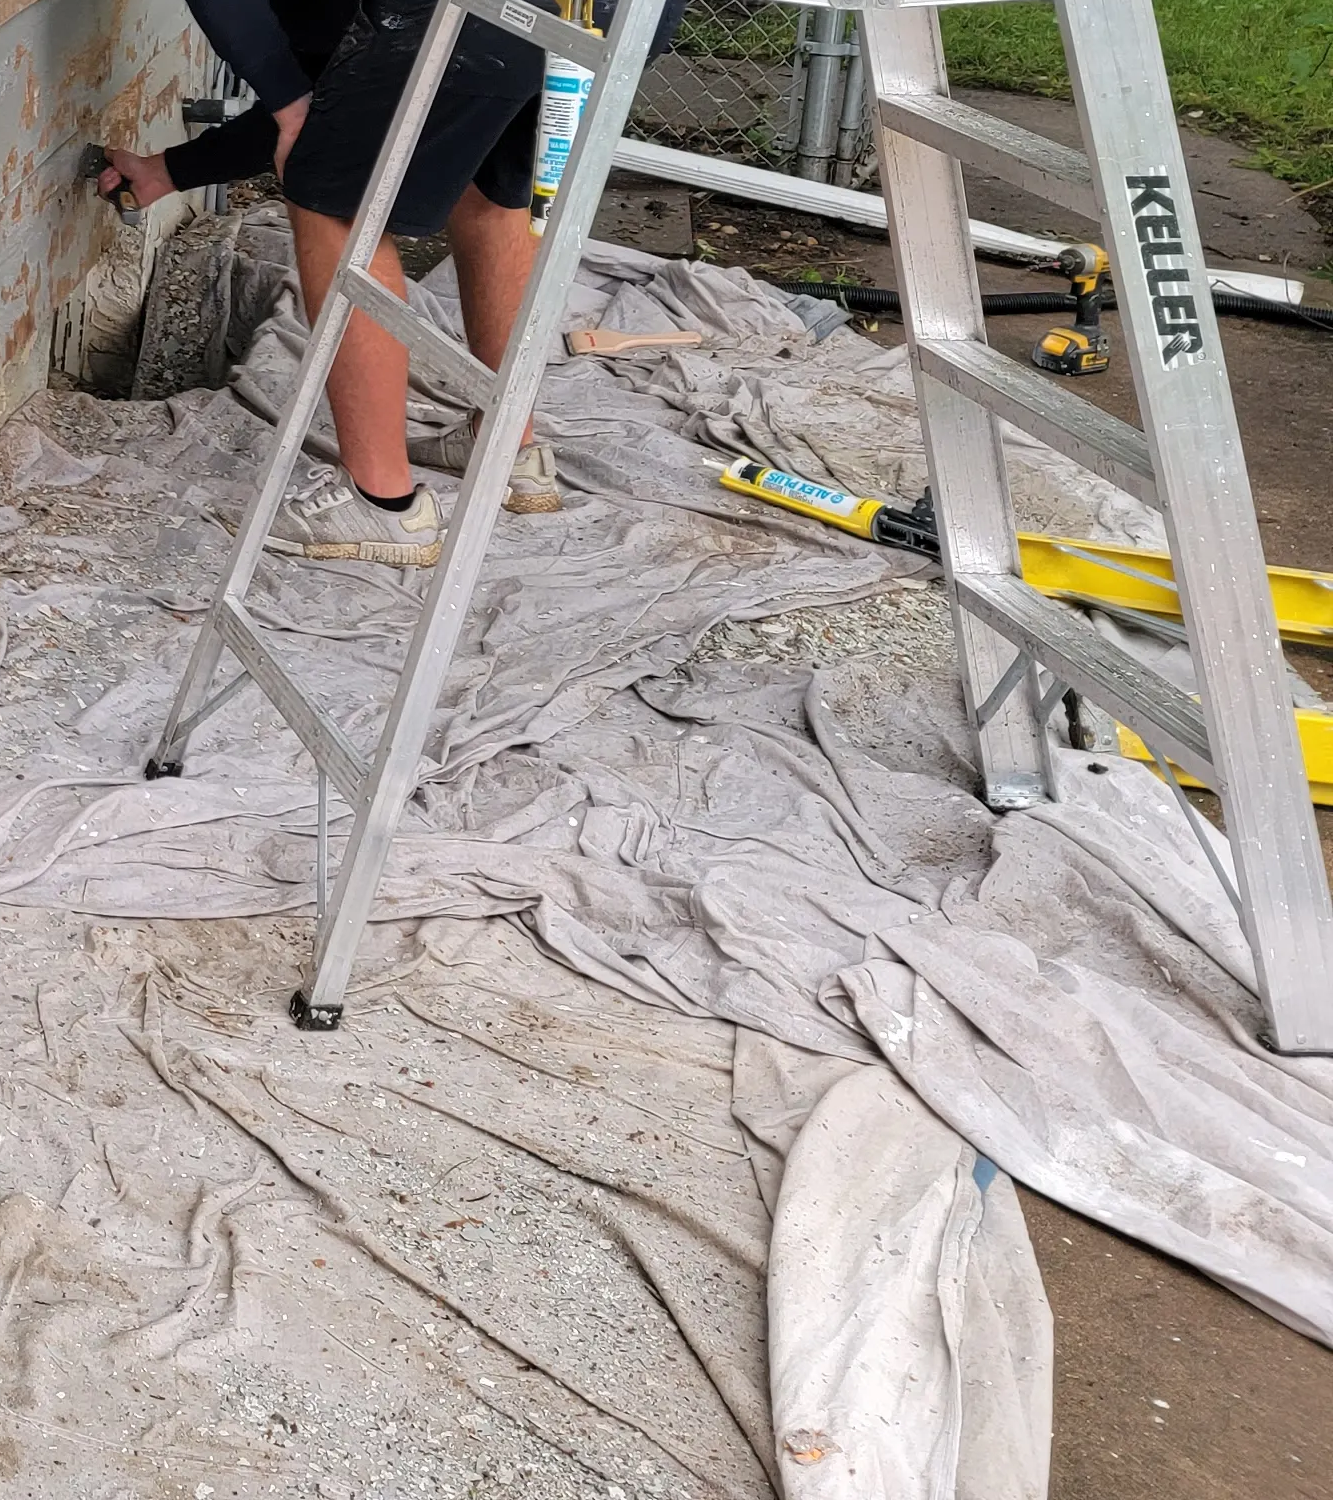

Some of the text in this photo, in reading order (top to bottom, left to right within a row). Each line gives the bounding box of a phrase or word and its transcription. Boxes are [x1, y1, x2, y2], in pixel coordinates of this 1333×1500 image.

[1125, 175, 1204, 366] KELLER
[767, 472, 799, 489] PLUS
[798, 484, 831, 499] ALEX
